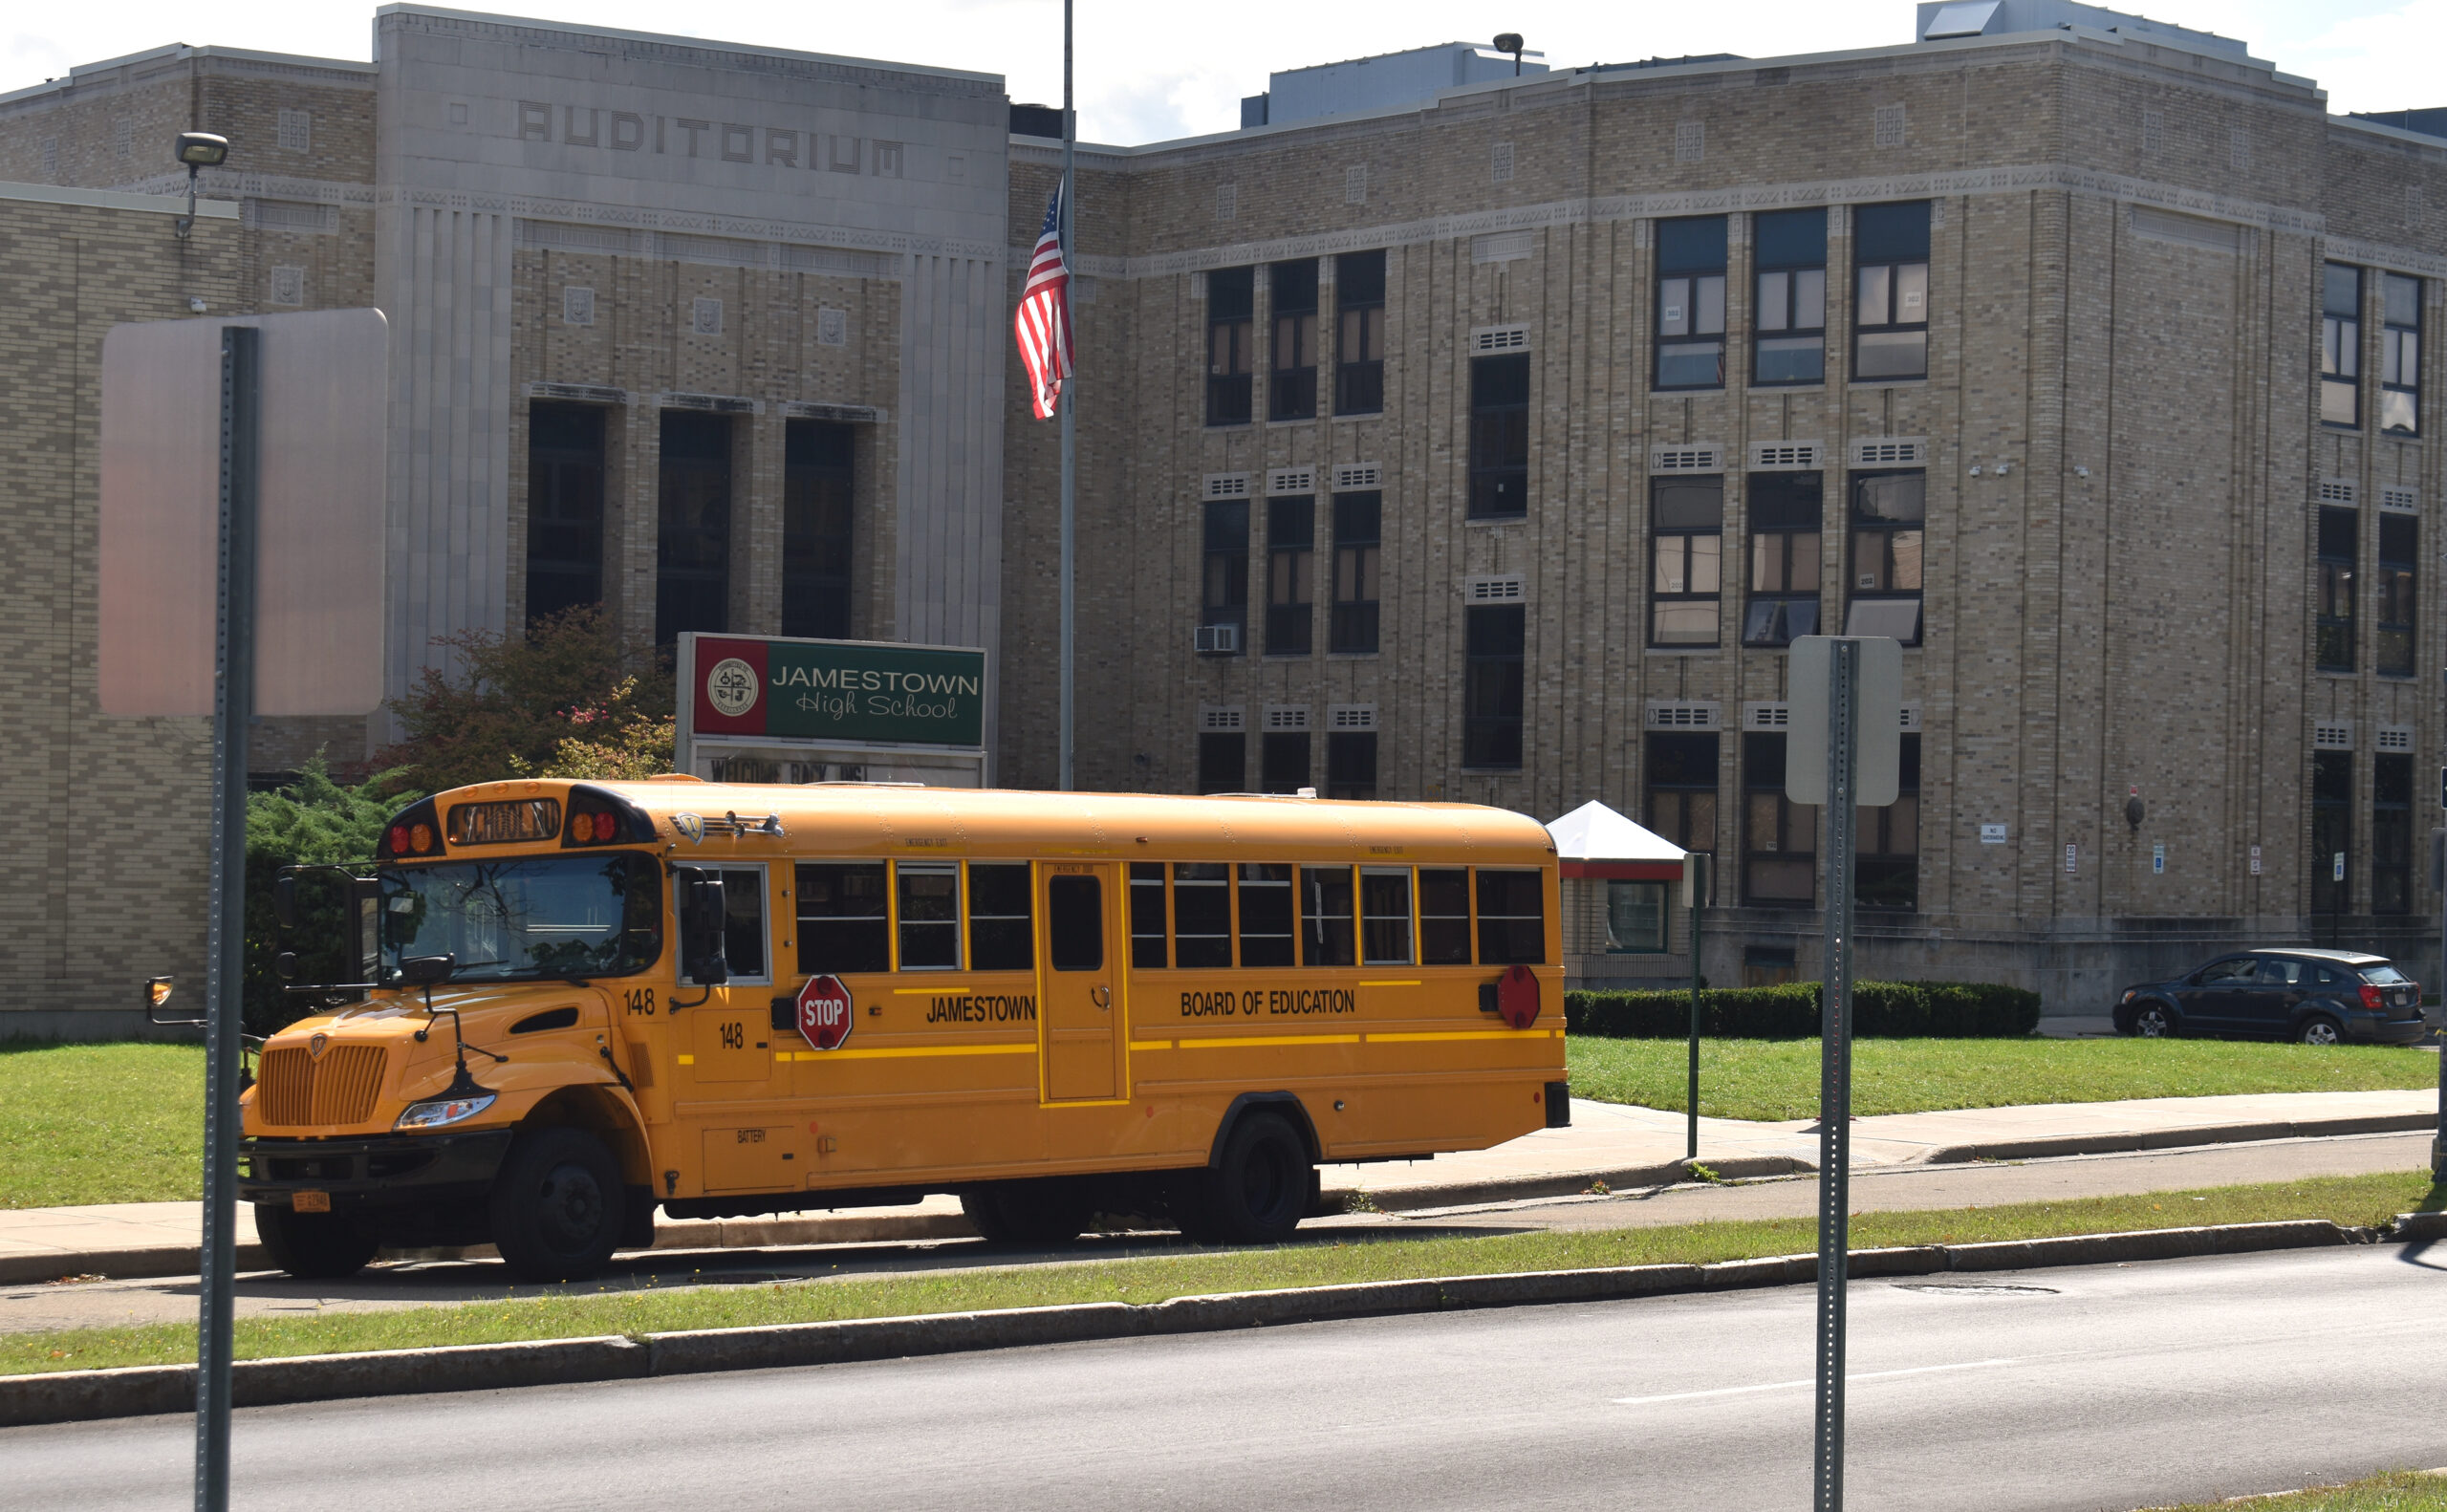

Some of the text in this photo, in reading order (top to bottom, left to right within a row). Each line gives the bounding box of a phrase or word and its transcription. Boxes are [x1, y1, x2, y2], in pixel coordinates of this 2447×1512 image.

[518, 100, 903, 179] AUDITORIUM
[772, 666, 978, 696] JAMESTOWN
[795, 691, 958, 721] High School
[624, 988, 656, 1016] 148
[806, 999, 843, 1026] STOP
[927, 995, 1036, 1023] JAMESTOWN
[1180, 989, 1354, 1016] BOARD OF EDUCATION
[720, 1022, 744, 1049] 148
[737, 1129, 767, 1144] BATTERY
